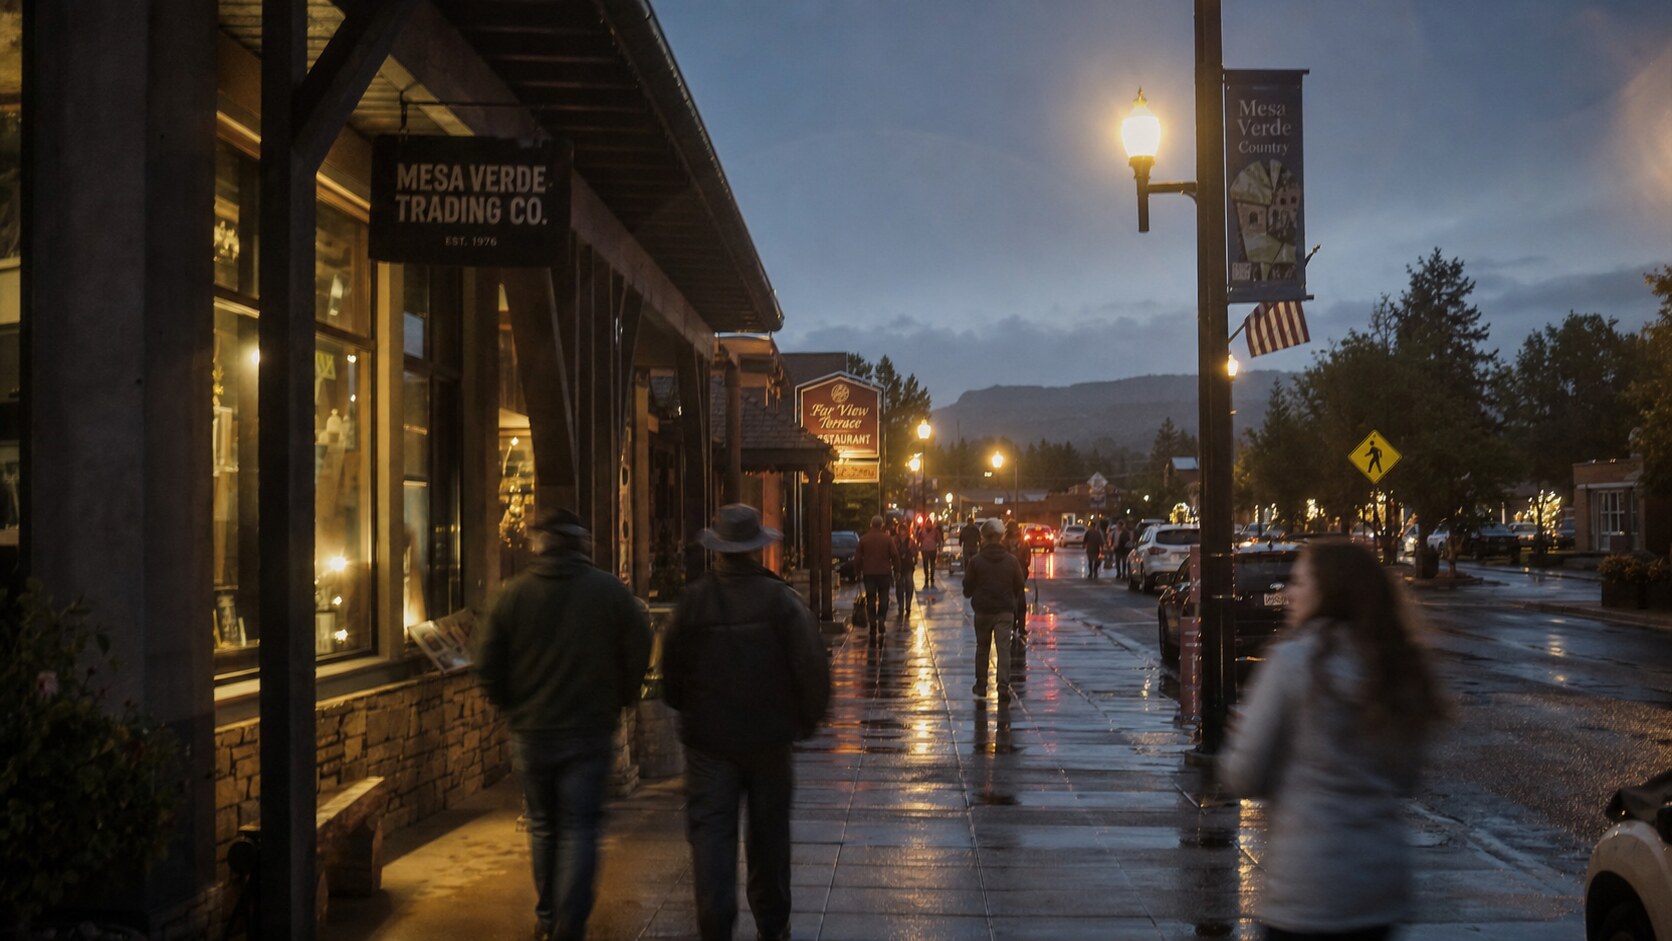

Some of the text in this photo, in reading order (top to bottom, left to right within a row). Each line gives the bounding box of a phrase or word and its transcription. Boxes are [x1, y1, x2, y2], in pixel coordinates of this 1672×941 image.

[1239, 100, 1286, 117] Mesa
[1237, 118, 1292, 136] Verde
[1238, 140, 1289, 156] Country
[396, 163, 546, 193] MESA VERDE
[395, 195, 549, 225] TRADING CO.
[445, 236, 497, 247] EST. 1976
[810, 403, 869, 416] Far View
[819, 416, 861, 429] Terrace
[817, 433, 871, 445] STAURANT
